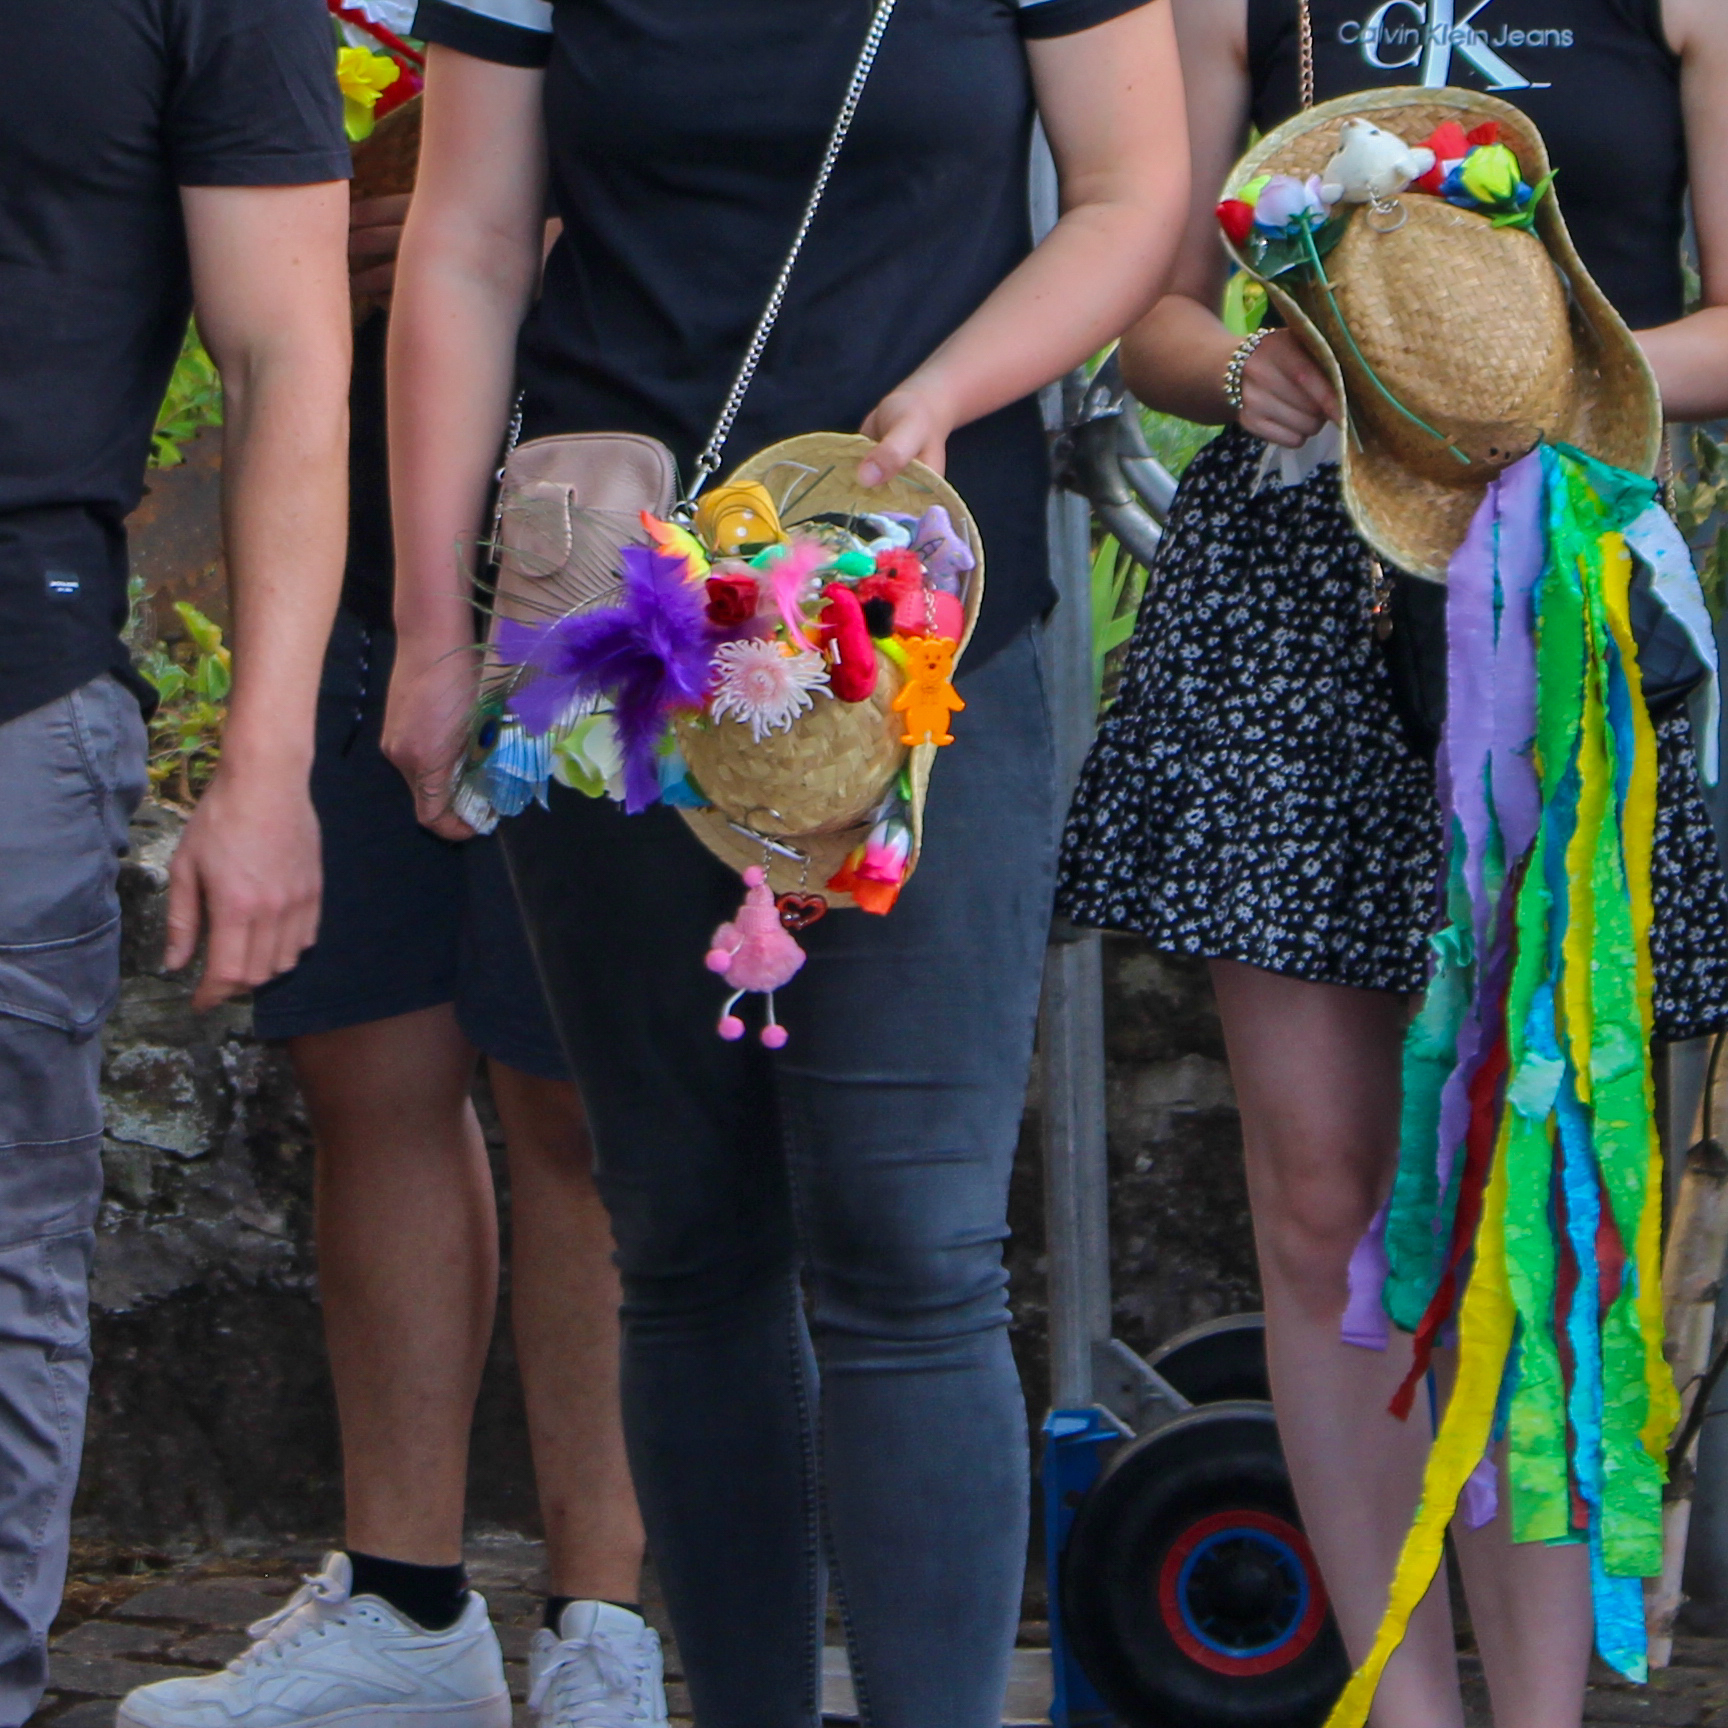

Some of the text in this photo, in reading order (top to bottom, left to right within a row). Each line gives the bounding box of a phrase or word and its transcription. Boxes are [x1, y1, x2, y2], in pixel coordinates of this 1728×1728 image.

[1337, 20, 1574, 48] Calvin Klein Jeans
